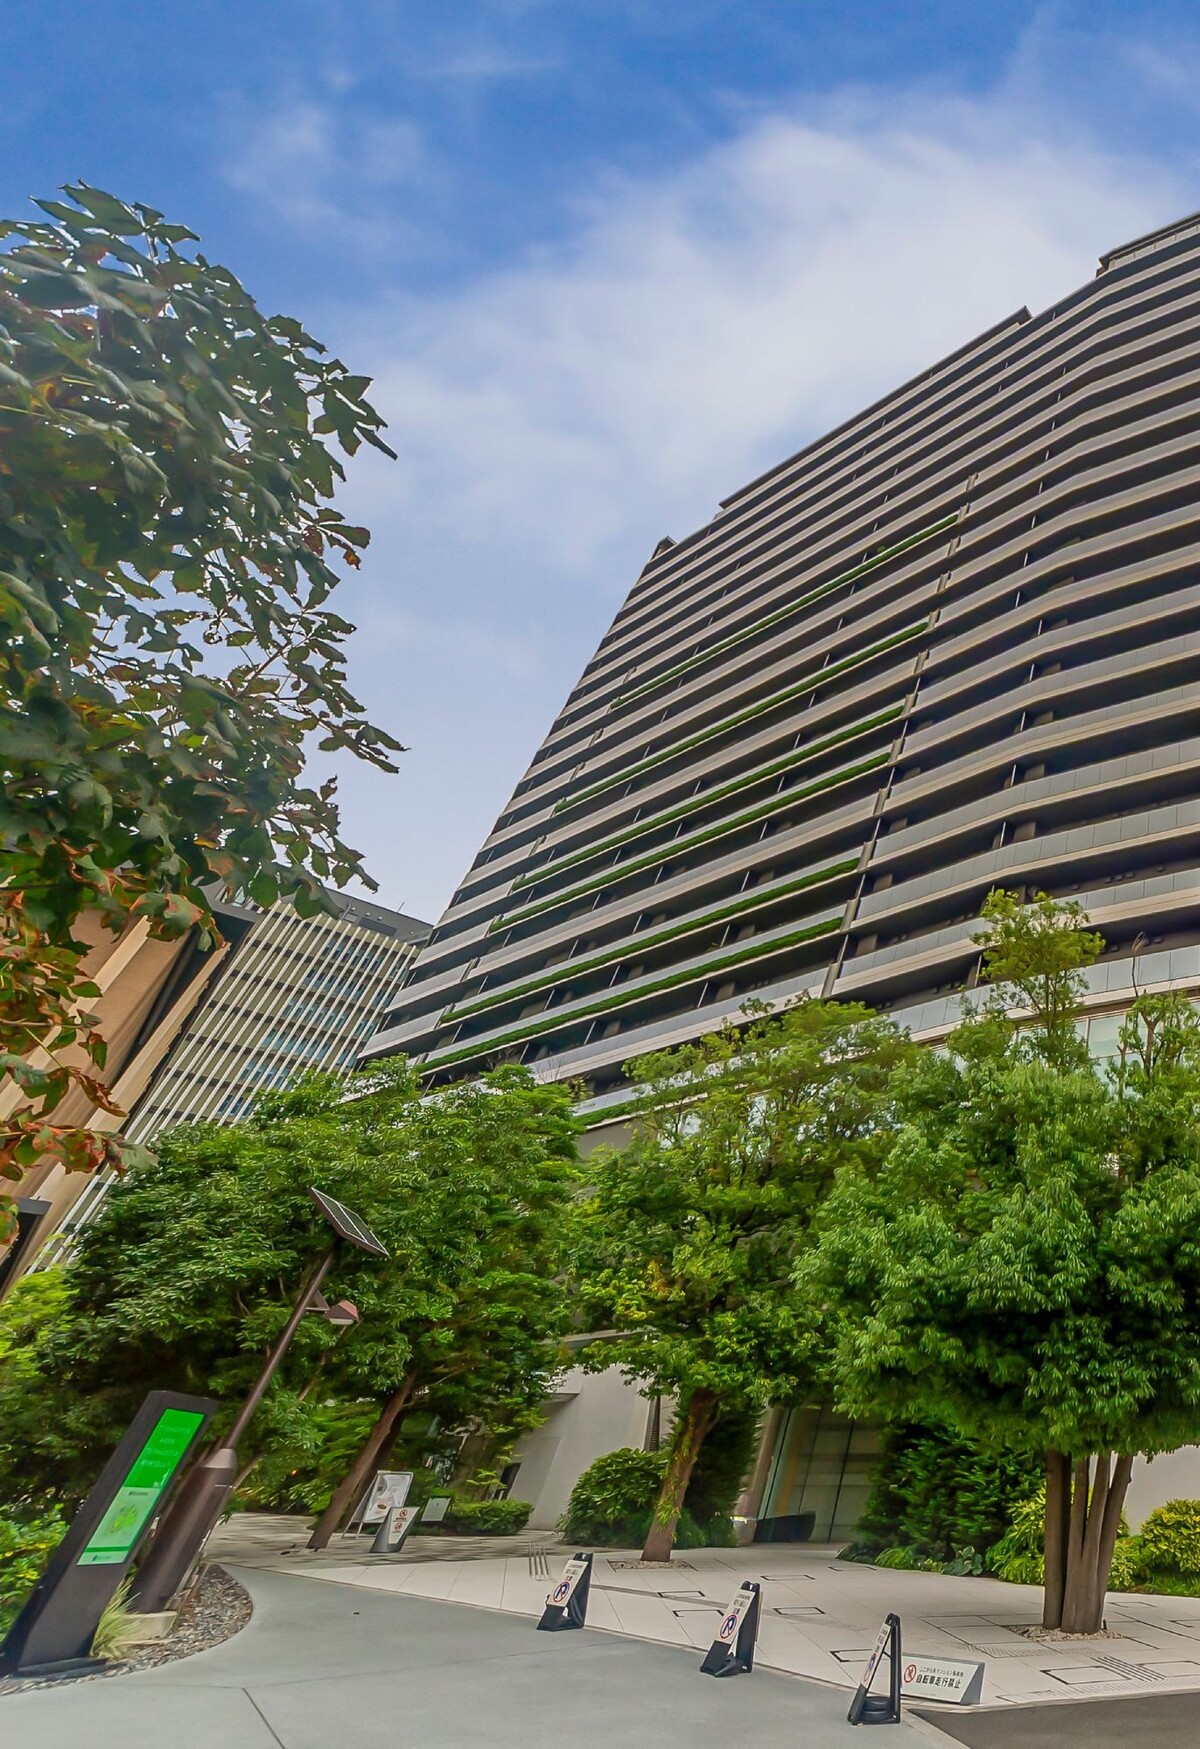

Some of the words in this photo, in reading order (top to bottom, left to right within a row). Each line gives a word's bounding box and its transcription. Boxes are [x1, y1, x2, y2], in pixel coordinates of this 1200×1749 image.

[916, 1674, 961, 1689] 自転車走行禁止
